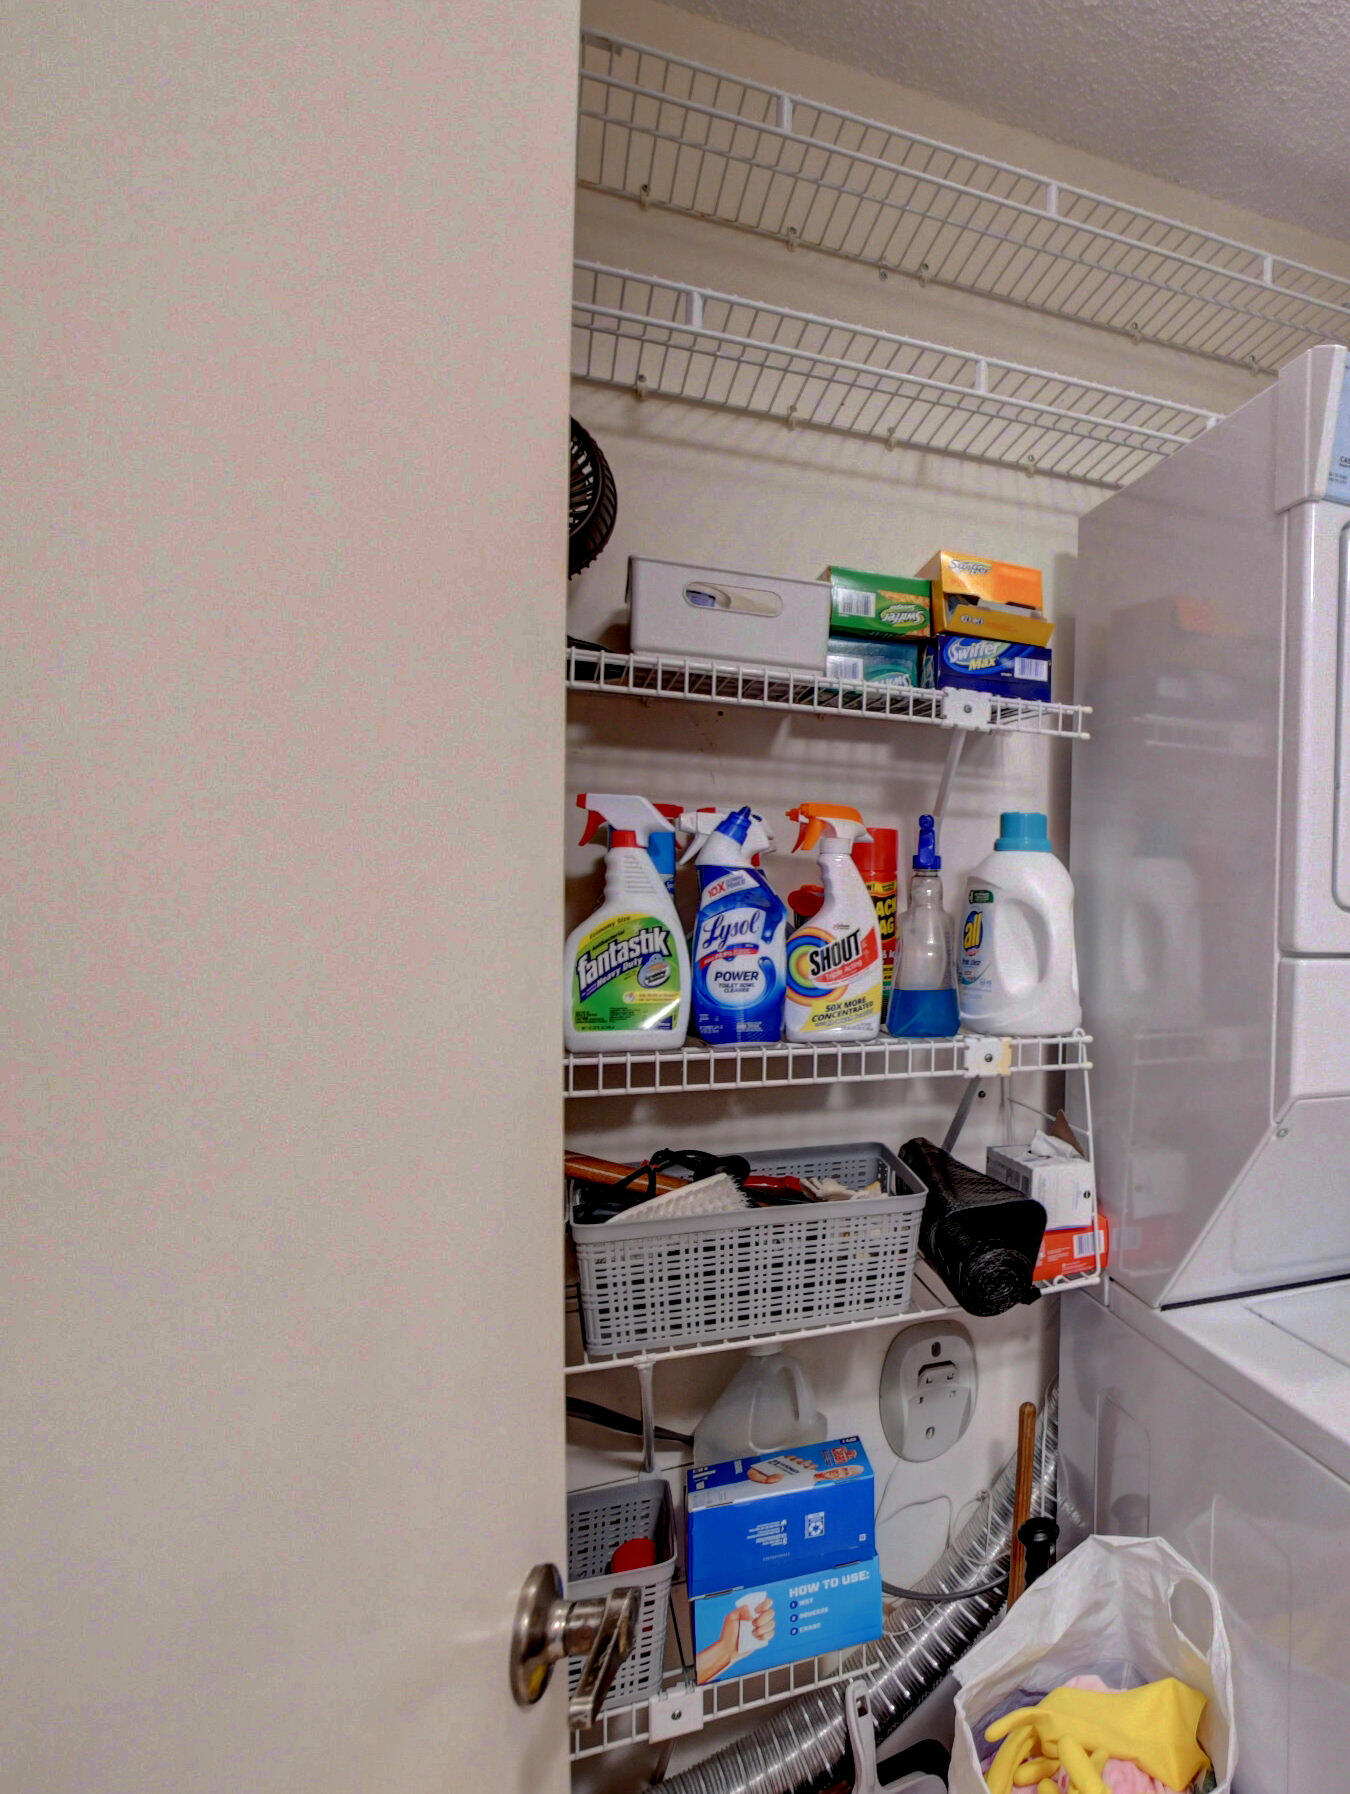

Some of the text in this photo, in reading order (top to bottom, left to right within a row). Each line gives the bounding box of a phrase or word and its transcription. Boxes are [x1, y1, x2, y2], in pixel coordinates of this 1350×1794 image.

[948, 560, 991, 576] Swiffer
[881, 609, 925, 625] Swiffer
[947, 637, 999, 663] Swiffer
[968, 656, 997, 672] Max
[707, 881, 726, 899] 10X
[702, 910, 762, 950] Lysol
[963, 912, 983, 949] all
[576, 926, 672, 992] fantastik
[809, 929, 861, 977] SHOUT
[622, 957, 643, 973] Duty
[714, 971, 759, 982] POWER
[811, 1001, 874, 1023] CONCENTRATED
[844, 996, 867, 1009] MORE
[789, 1570, 870, 1598] HOW TO USE:
